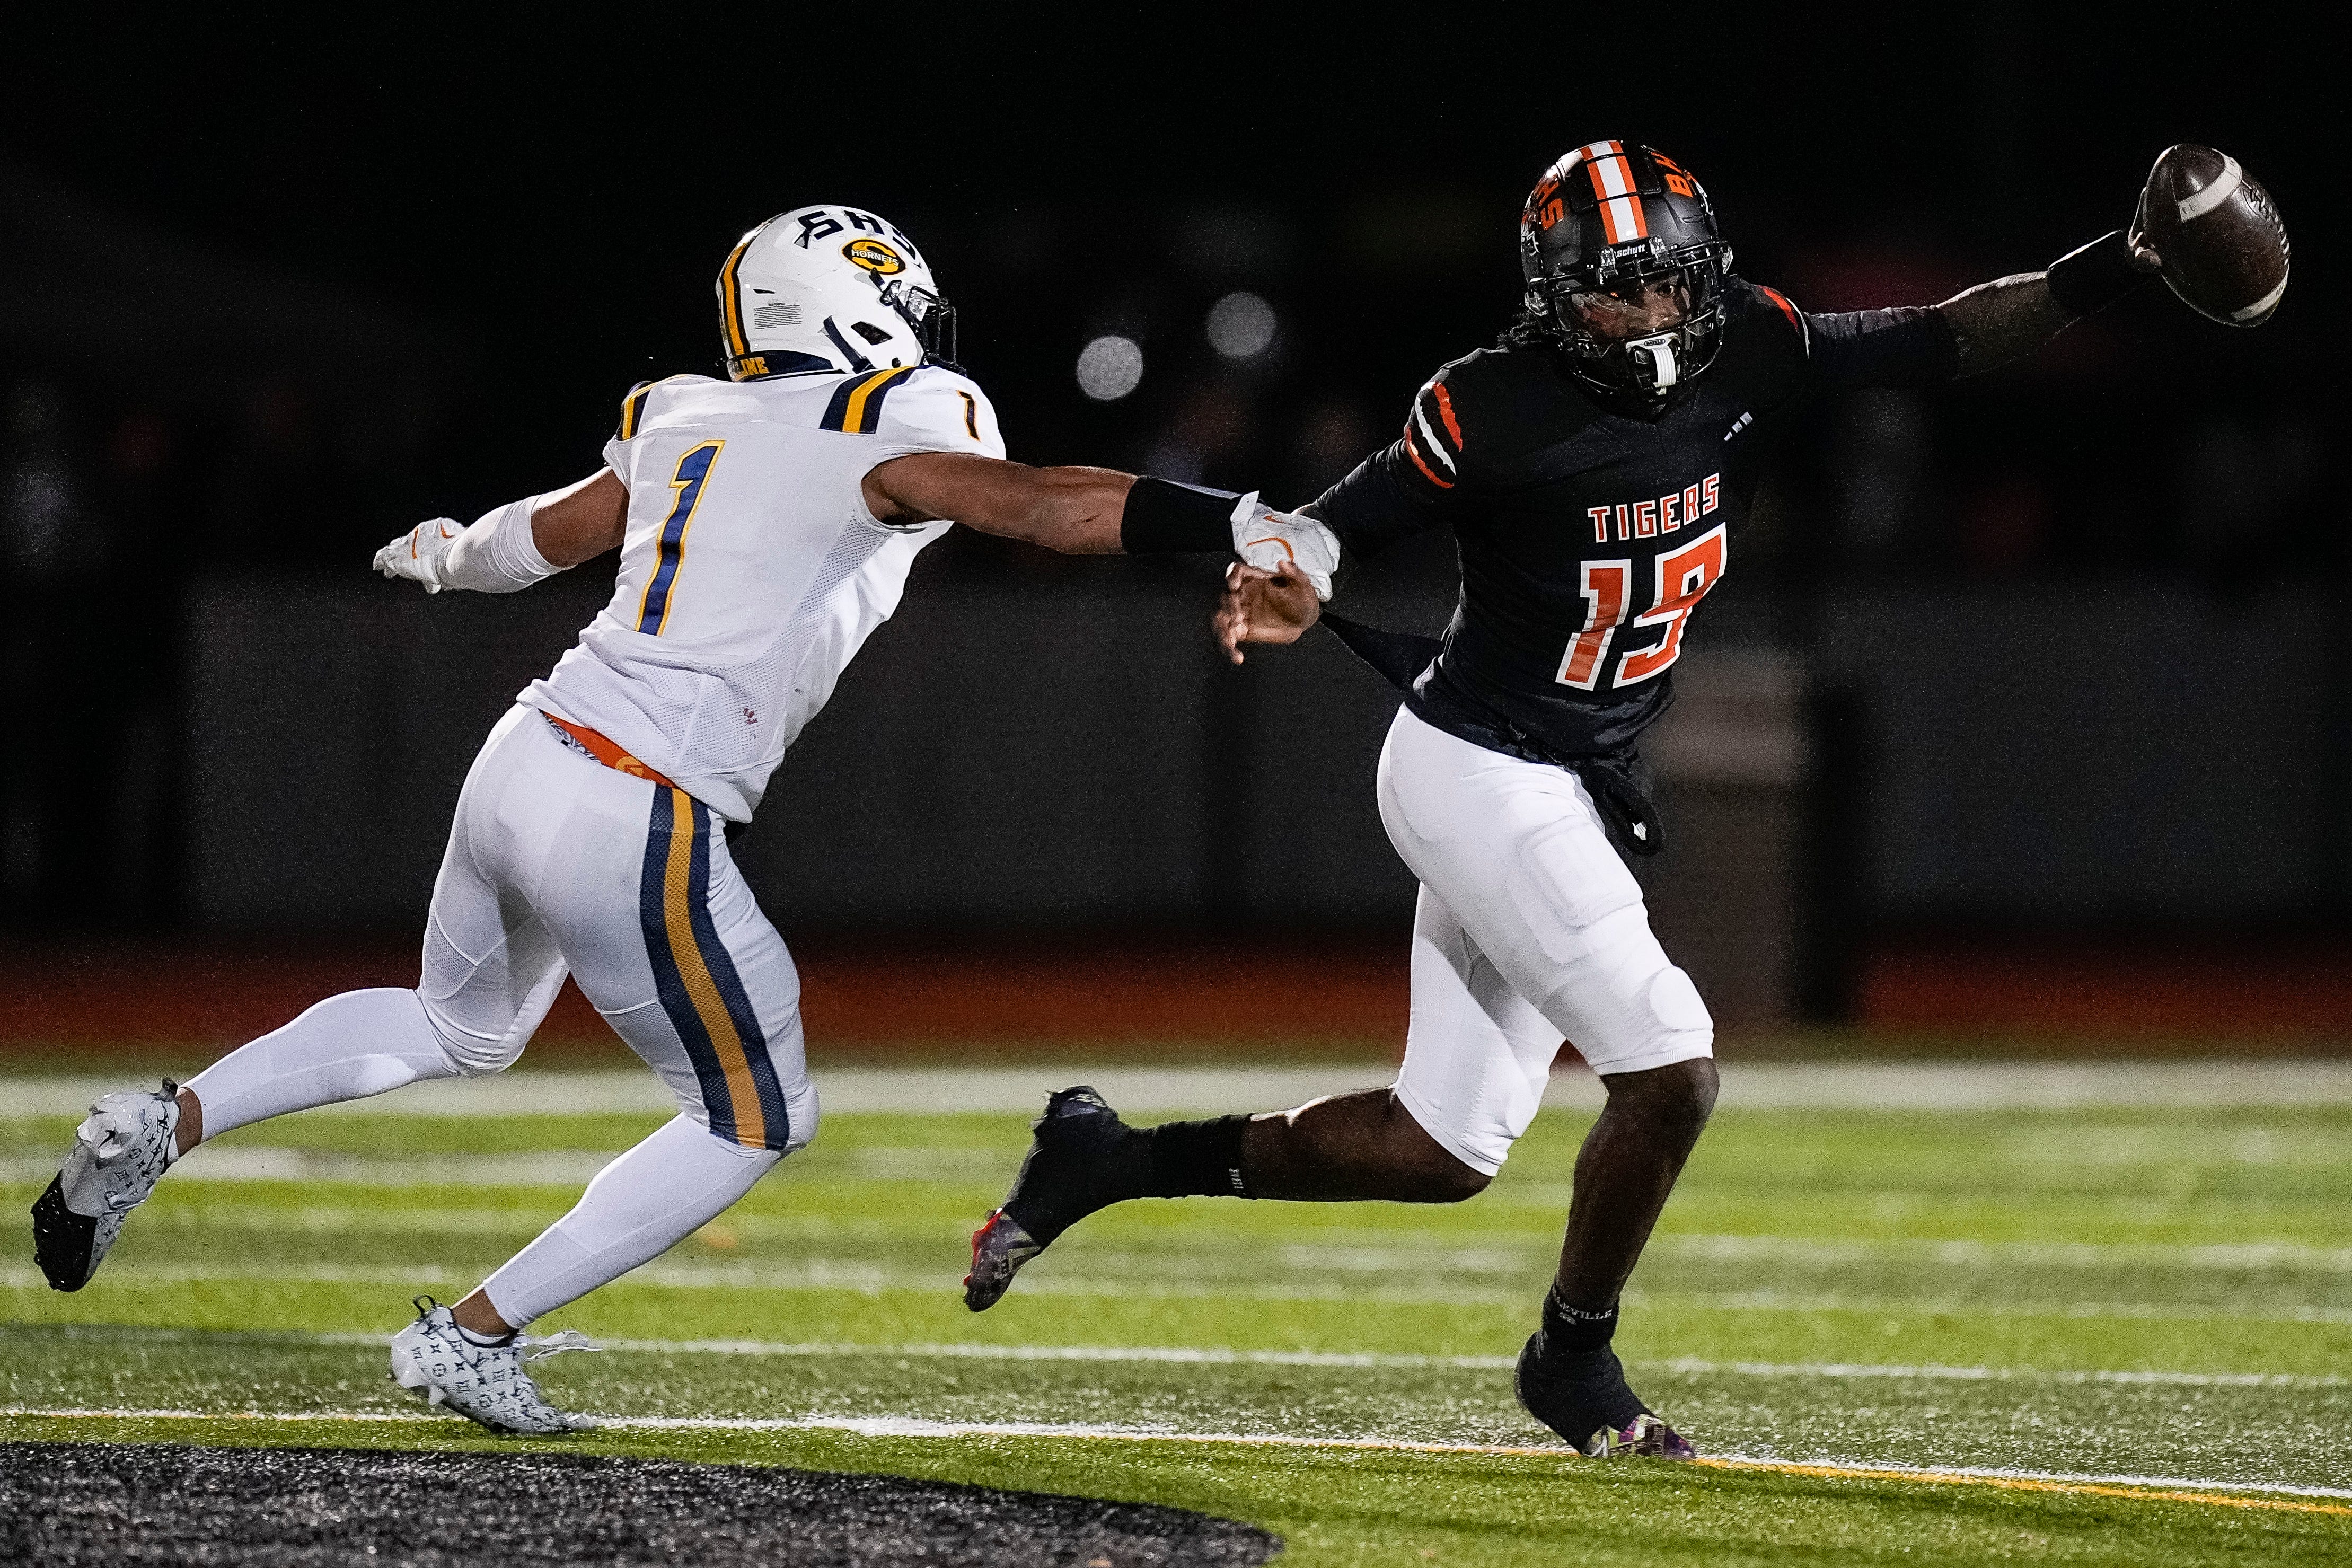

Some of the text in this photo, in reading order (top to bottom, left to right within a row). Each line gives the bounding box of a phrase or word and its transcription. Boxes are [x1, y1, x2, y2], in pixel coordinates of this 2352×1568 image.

[851, 249, 900, 266] HORNETS
[1617, 244, 1645, 257] schutt
[956, 390, 981, 442] 1
[635, 439, 726, 636] 1
[1588, 473, 1719, 543] TIGERS
[1555, 522, 1727, 691] 19
